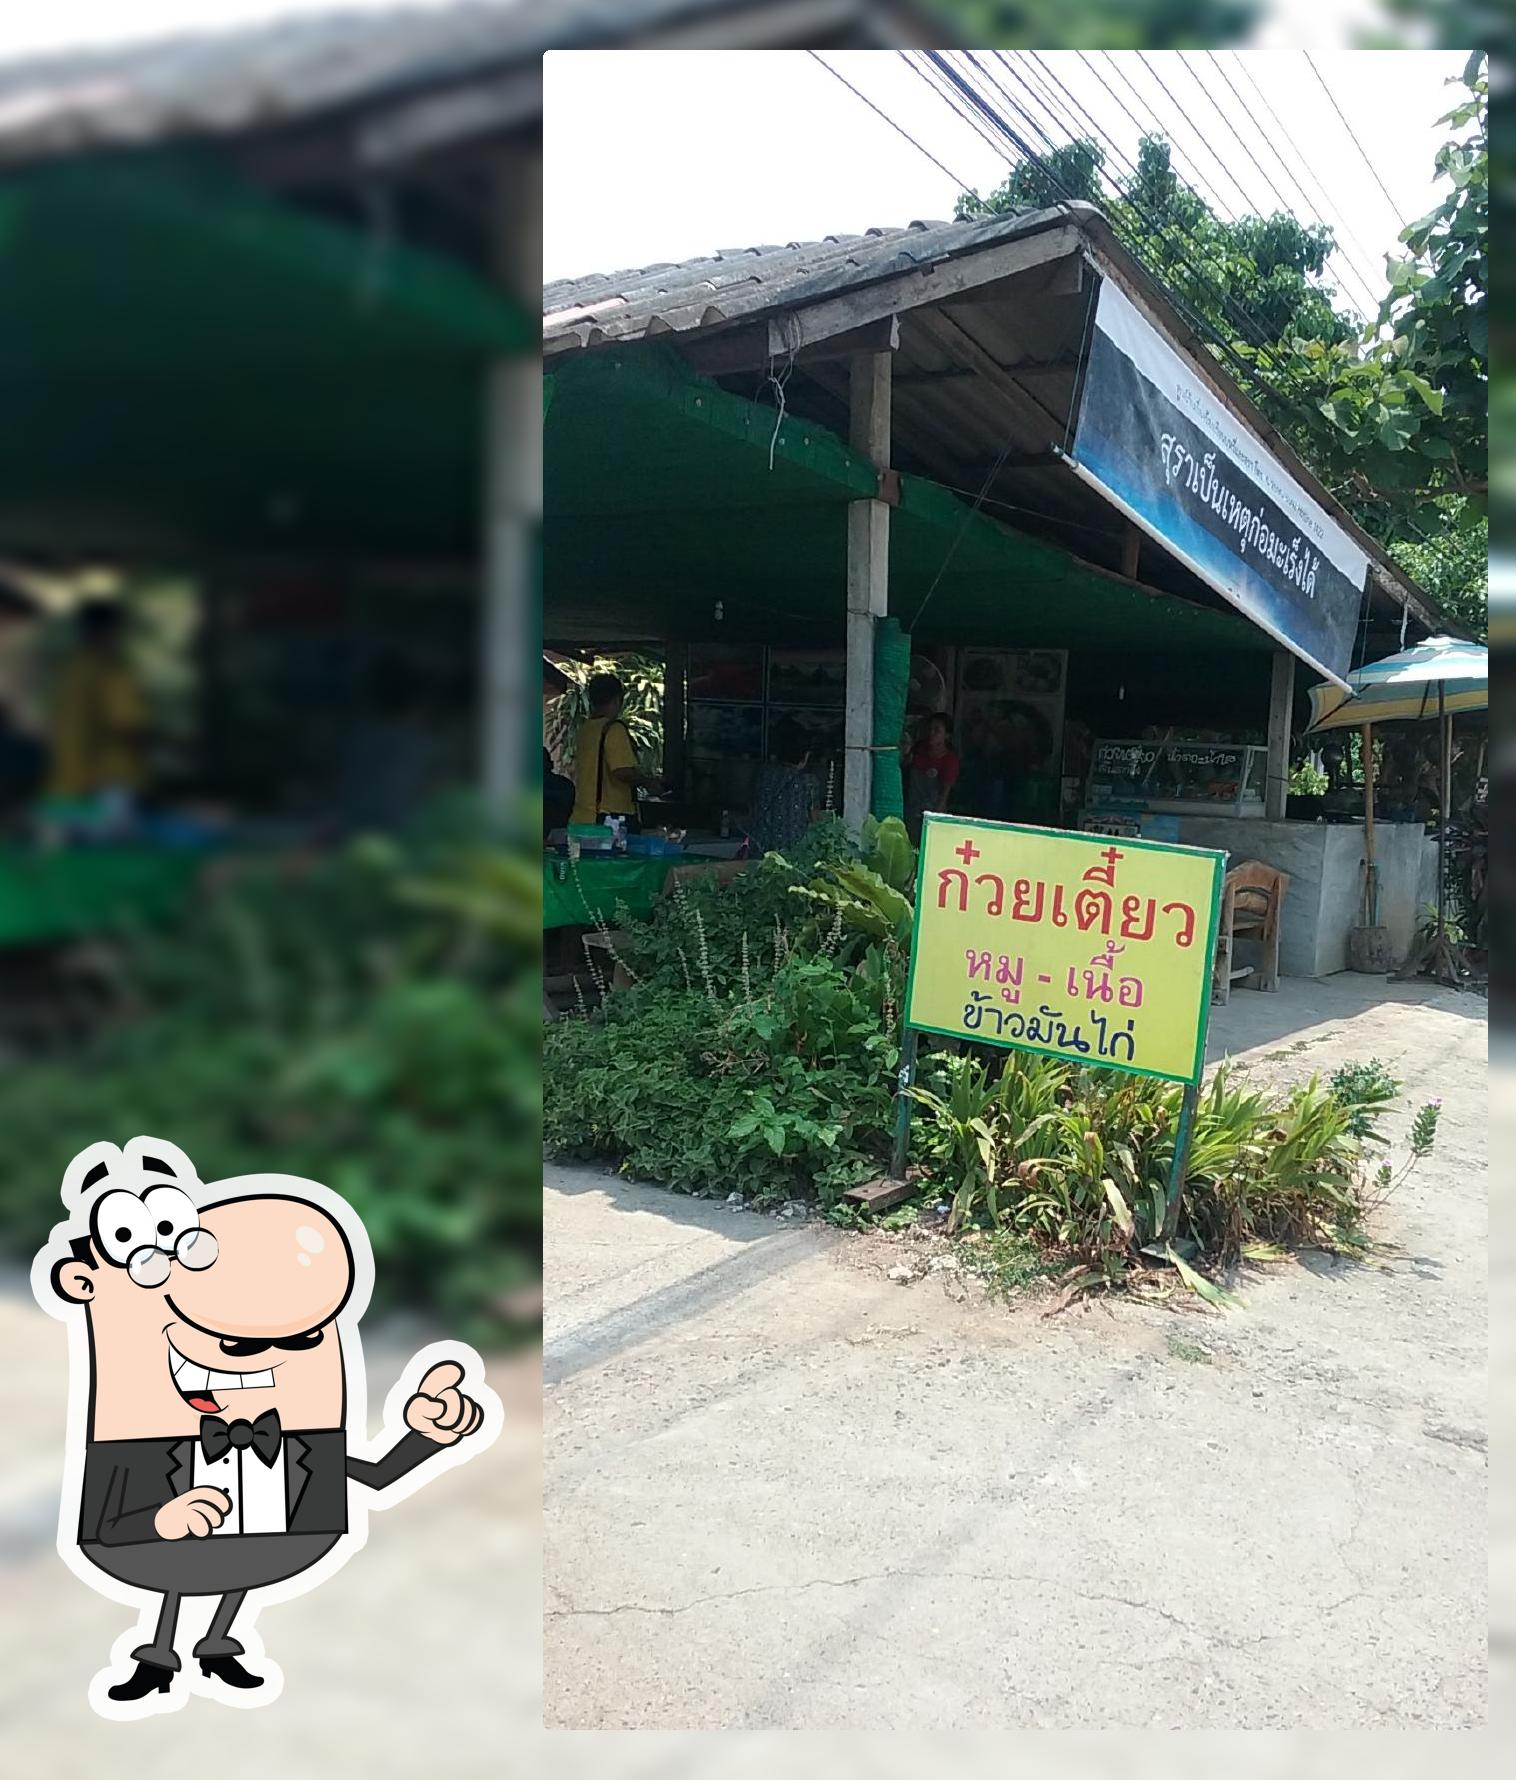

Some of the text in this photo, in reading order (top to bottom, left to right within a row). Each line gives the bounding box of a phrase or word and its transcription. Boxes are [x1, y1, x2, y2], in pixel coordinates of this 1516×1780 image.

[1161, 433, 1318, 597] สุราเป็นเหตุก่อมะเร็งได้
[937, 840, 1197, 947] ก๋วยเตี๋ยว
[965, 949, 1023, 1005] หมู
[1066, 940, 1144, 1008] เนื้อ
[963, 990, 1136, 1062] ข้าวมันไก่
